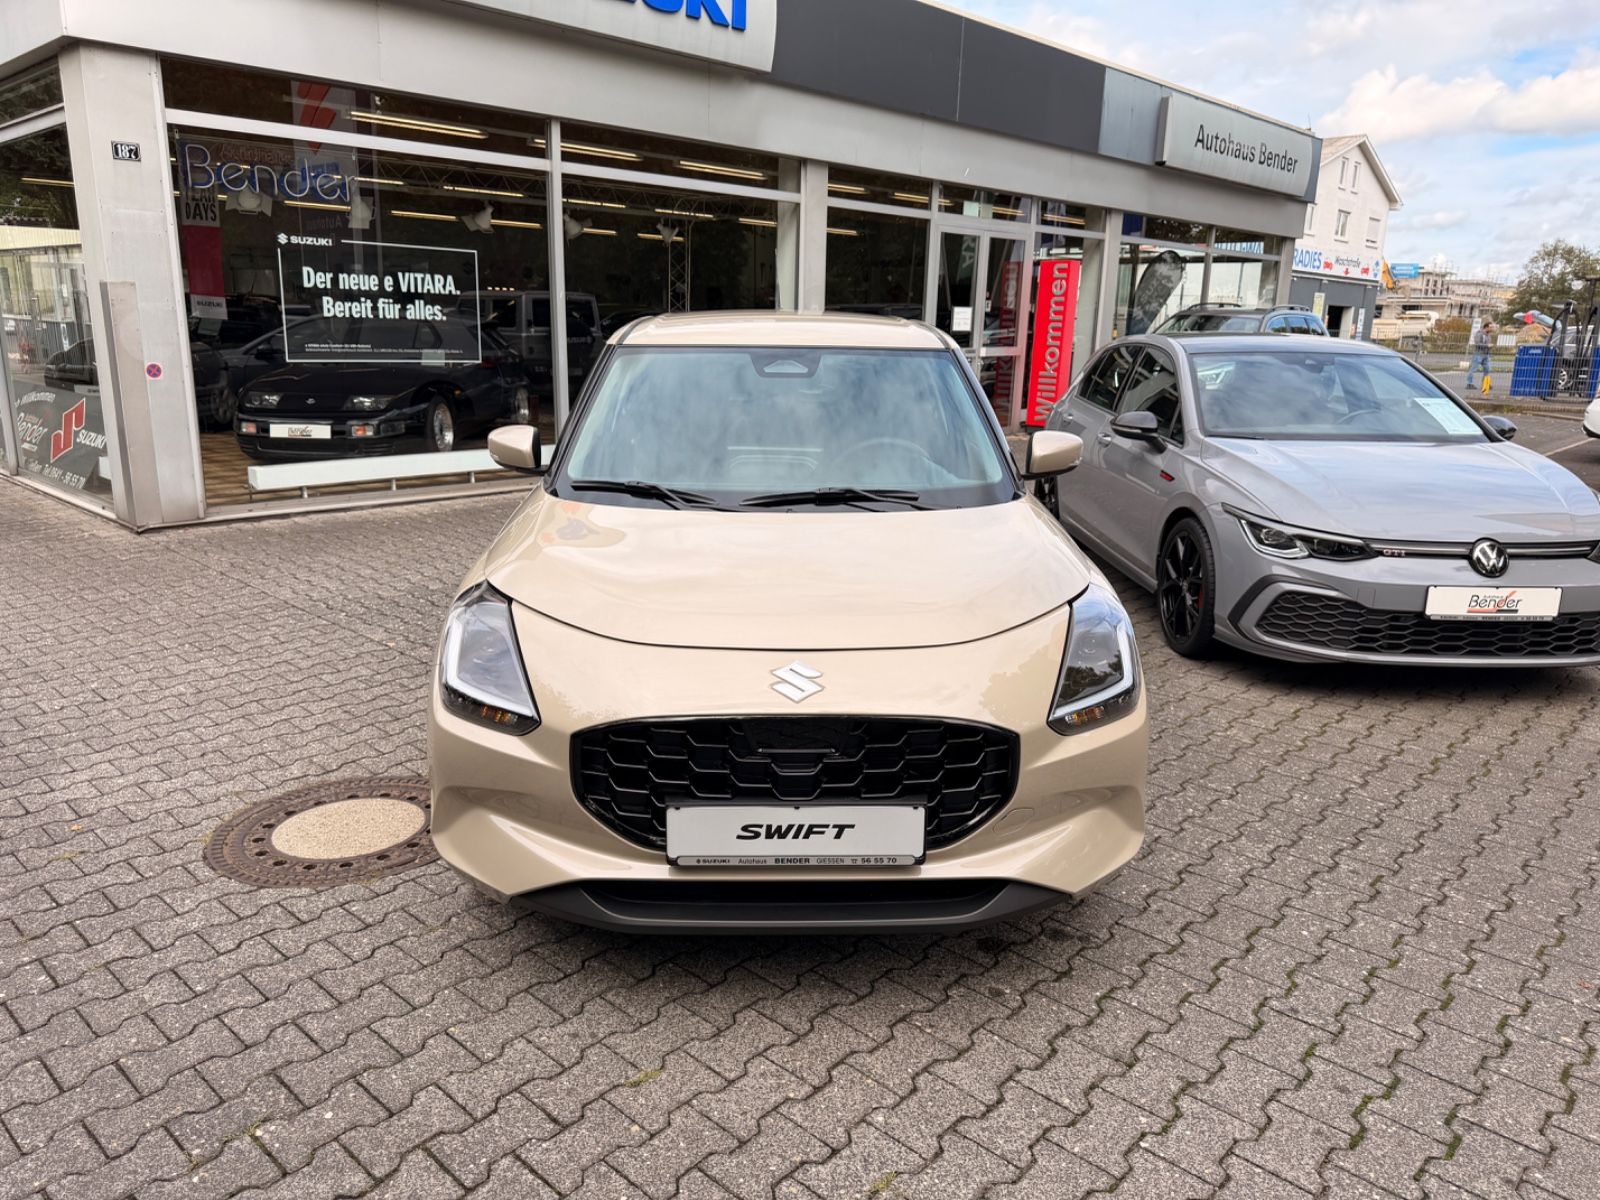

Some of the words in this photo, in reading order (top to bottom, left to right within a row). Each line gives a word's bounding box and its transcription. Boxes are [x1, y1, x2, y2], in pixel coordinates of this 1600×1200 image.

[116, 143, 137, 159] 187
[1194, 123, 1257, 163] Autohaus
[1258, 142, 1299, 174] Bender
[184, 143, 356, 202] Bender
[185, 202, 217, 222] DAYS
[290, 235, 333, 247] SUZUKI
[302, 265, 333, 289] Der
[338, 272, 379, 292] neue
[383, 274, 394, 292] e
[397, 271, 462, 296] VITARA.
[322, 295, 374, 319] Bereit
[377, 297, 402, 319] für
[405, 300, 448, 321] alles.
[1033, 262, 1069, 423] Willkommen
[76, 428, 108, 450] SUZUKI
[1383, 549, 1406, 557] GTI
[1468, 592, 1523, 609] Bender
[735, 823, 856, 841] SWIFT
[738, 857, 767, 865] Autohaus
[774, 857, 811, 865] BENDER
[816, 857, 845, 865] GIESSEN
